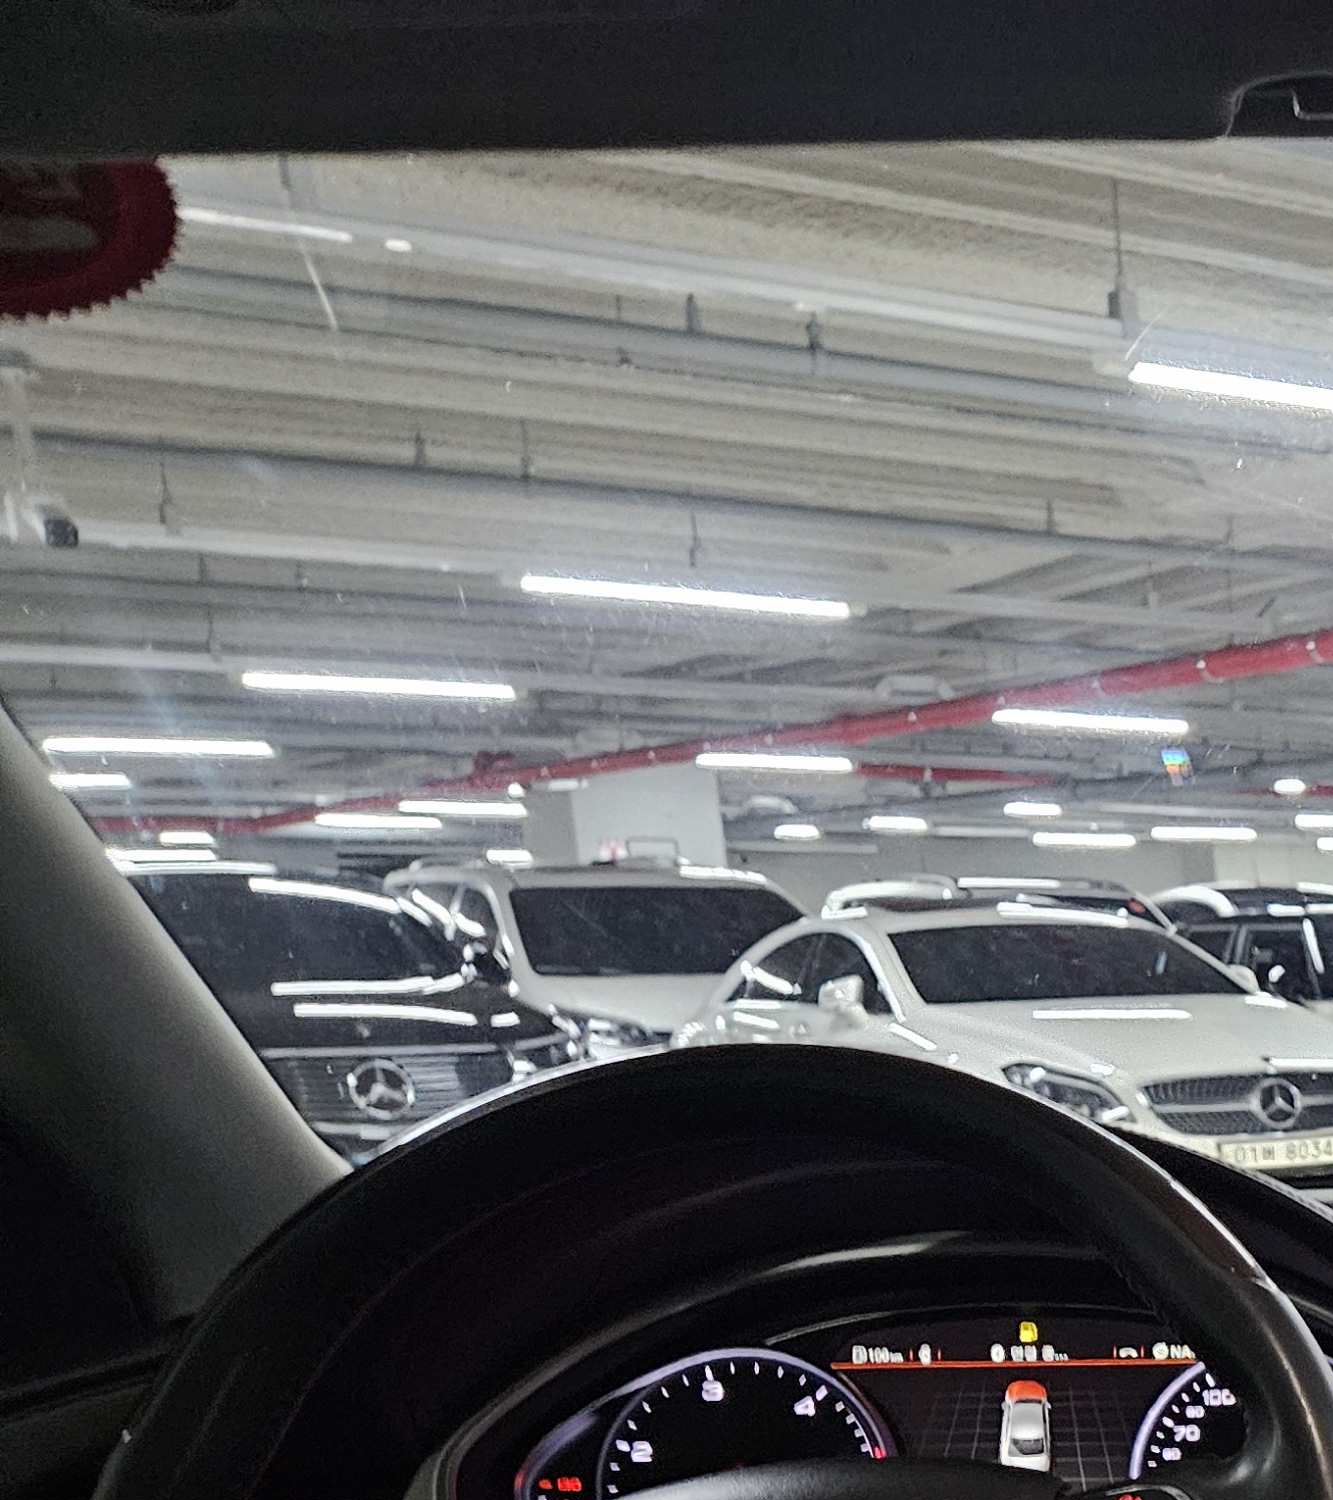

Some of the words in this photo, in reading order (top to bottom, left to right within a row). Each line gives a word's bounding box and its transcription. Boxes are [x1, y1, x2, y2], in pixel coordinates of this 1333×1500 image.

[701, 1379, 724, 1402] 3
[1202, 1388, 1237, 1407] 100
[793, 1395, 816, 1417] 4
[631, 1440, 653, 1463] 2
